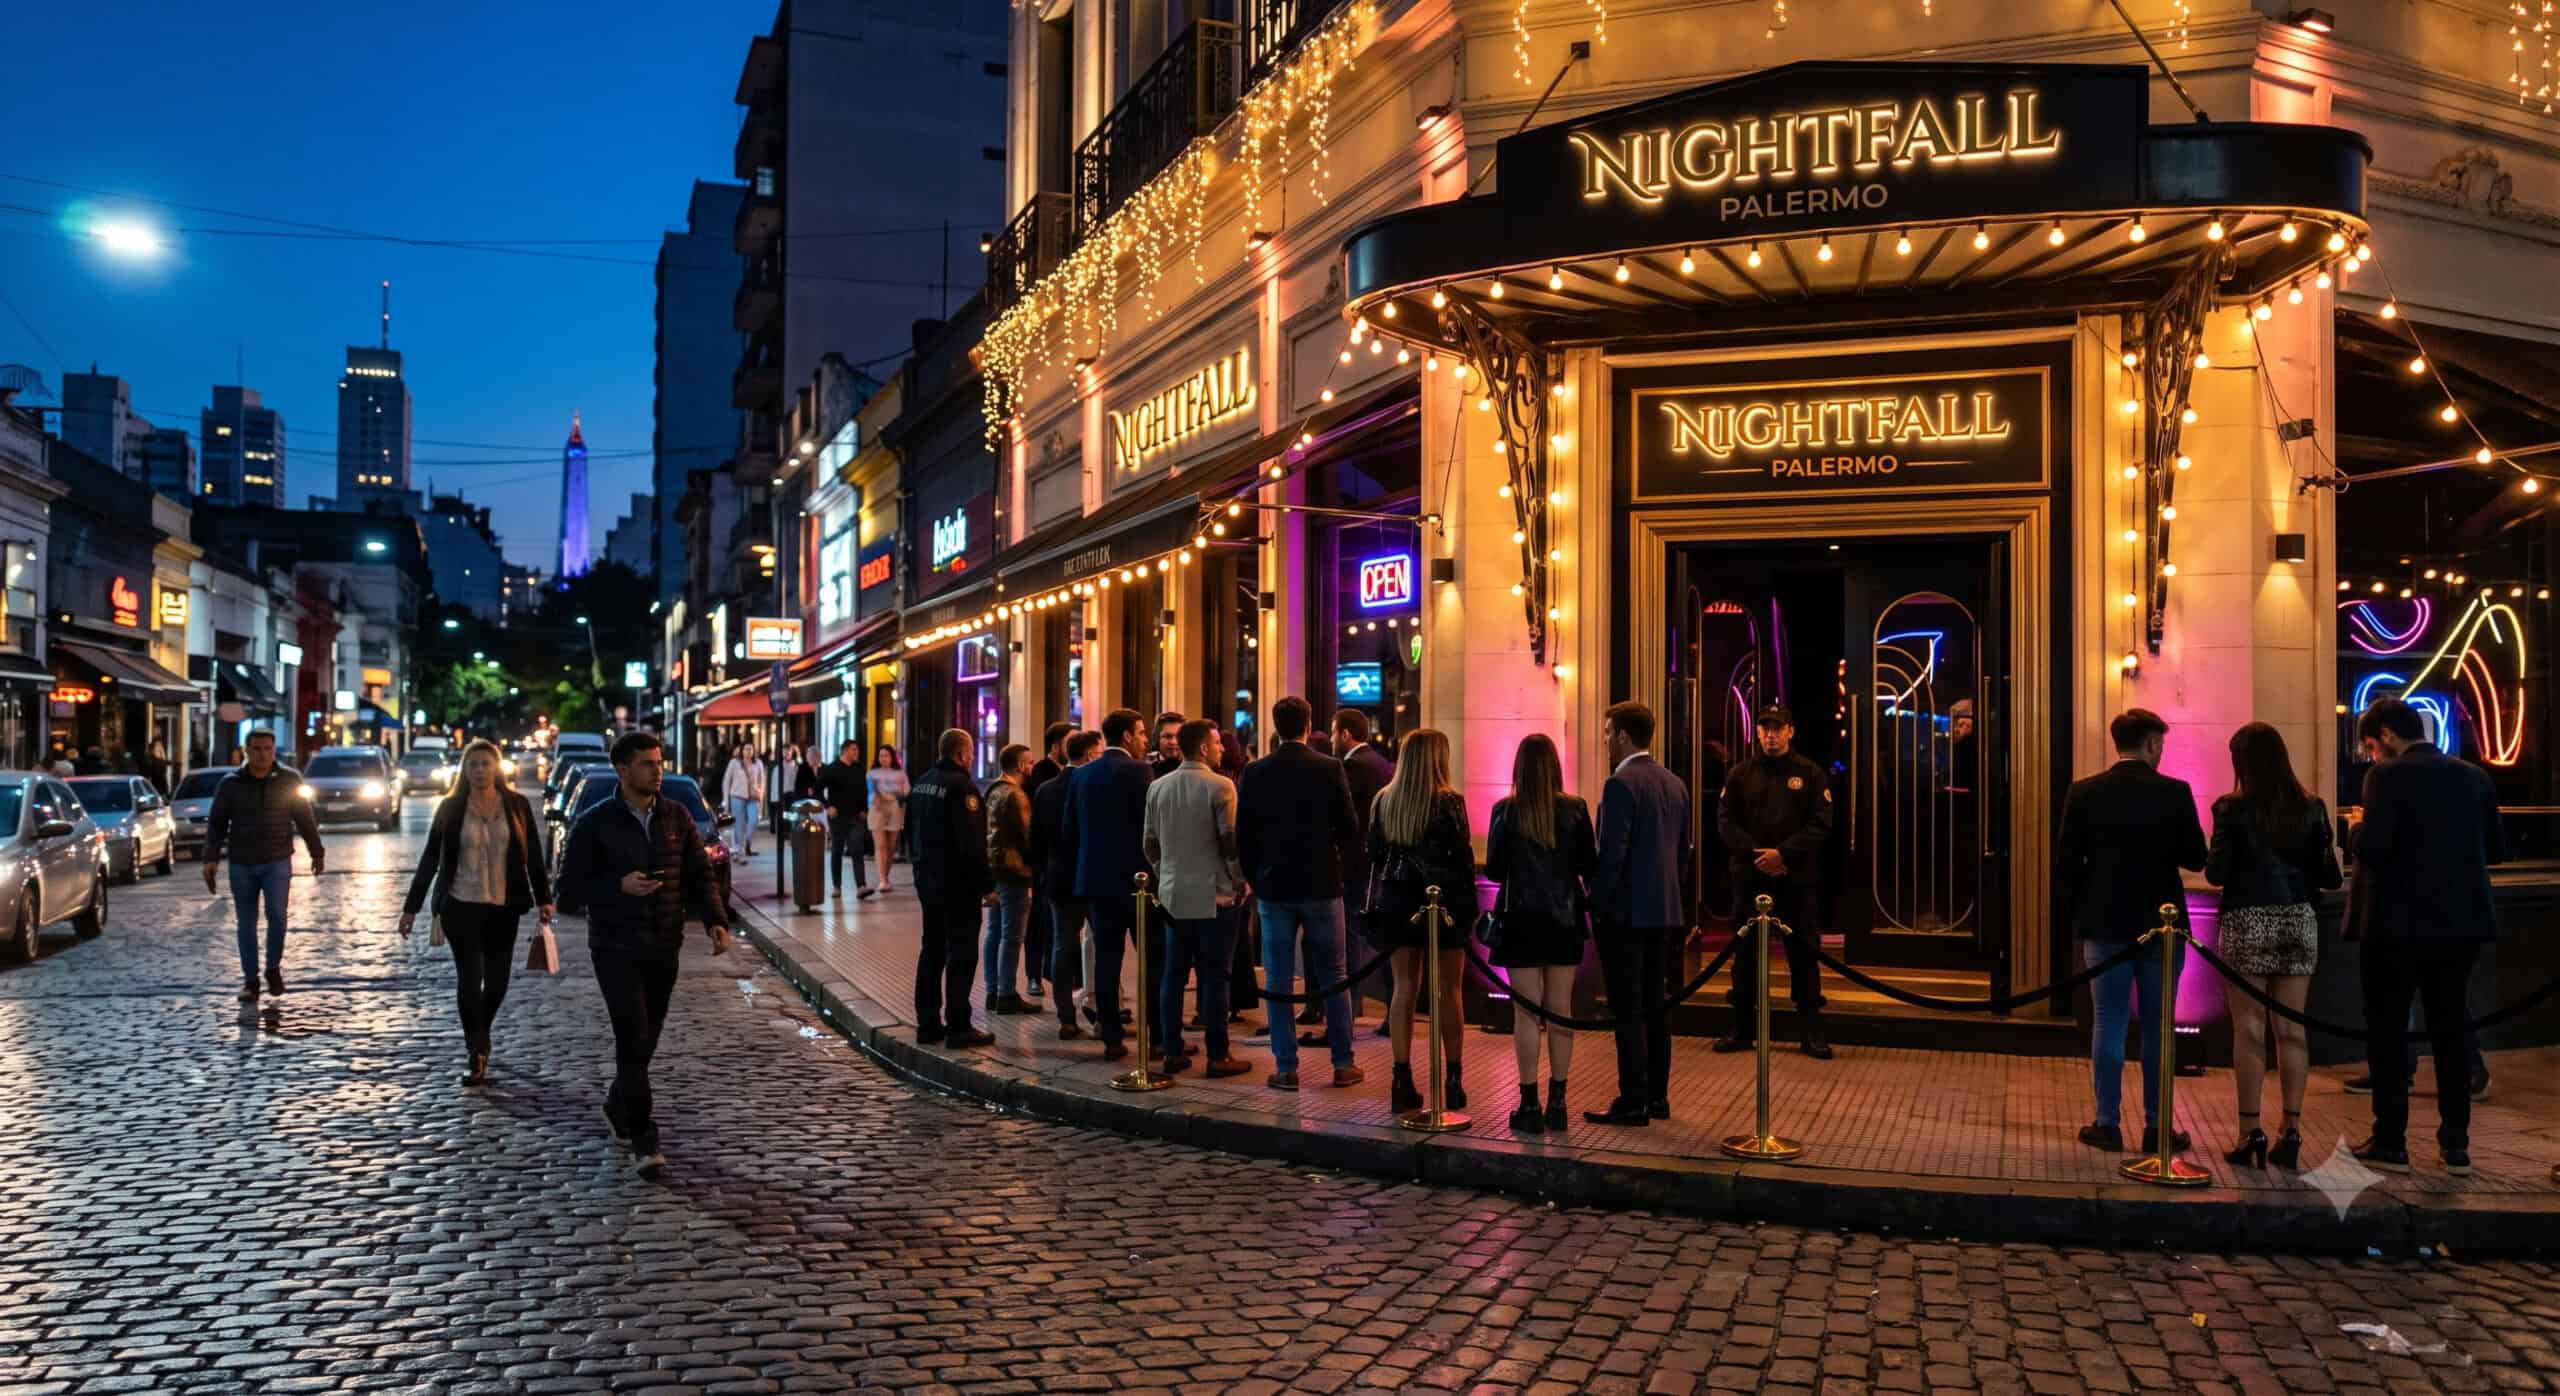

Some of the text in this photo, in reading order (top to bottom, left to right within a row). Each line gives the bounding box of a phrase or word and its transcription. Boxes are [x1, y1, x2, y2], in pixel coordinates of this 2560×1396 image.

[1567, 89, 2061, 201] NIGHTFALL
[1720, 183, 1889, 222] PALERMO
[1108, 348, 1256, 468] NIGHTFALL
[1661, 392, 2010, 458] NIGHTFALL
[1772, 455, 1898, 478] PALERMO
[1364, 561, 1408, 601] OPEN
